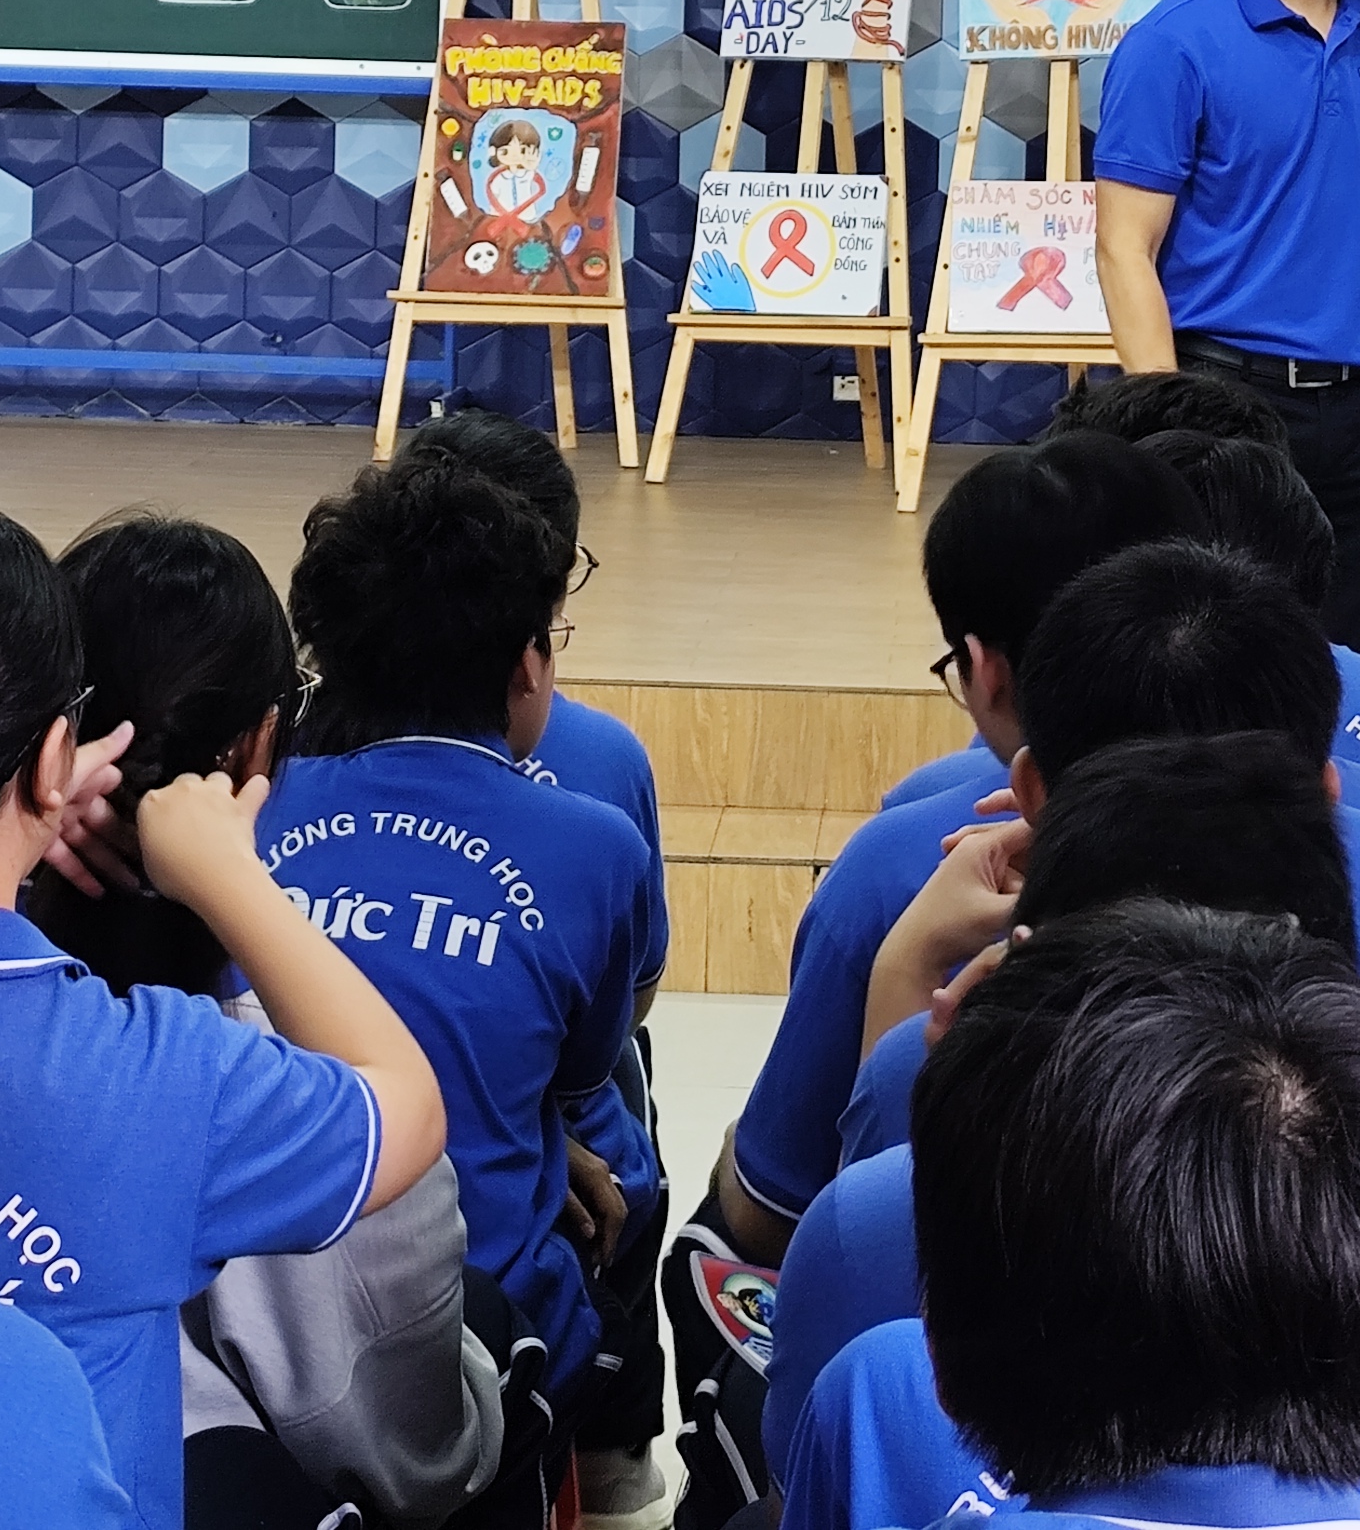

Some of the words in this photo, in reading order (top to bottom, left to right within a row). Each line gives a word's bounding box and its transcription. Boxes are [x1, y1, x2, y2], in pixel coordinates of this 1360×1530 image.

[966, 19, 1059, 54] KHÔNG
[445, 33, 541, 77] PHÒNG
[542, 32, 624, 76] CHỐNG
[467, 76, 604, 109] HIV-AIDS
[800, 182, 835, 199] HIV
[951, 183, 1016, 206] CHĂM
[1026, 183, 1073, 211] SÓC
[702, 227, 729, 245] VÀ
[952, 241, 1022, 261] CHUNG
[958, 261, 1001, 283] TAY
[261, 813, 356, 874] ƯỜNG
[371, 811, 491, 864] TRUNG
[490, 857, 545, 932] HỌC
[410, 892, 507, 967] Trí
